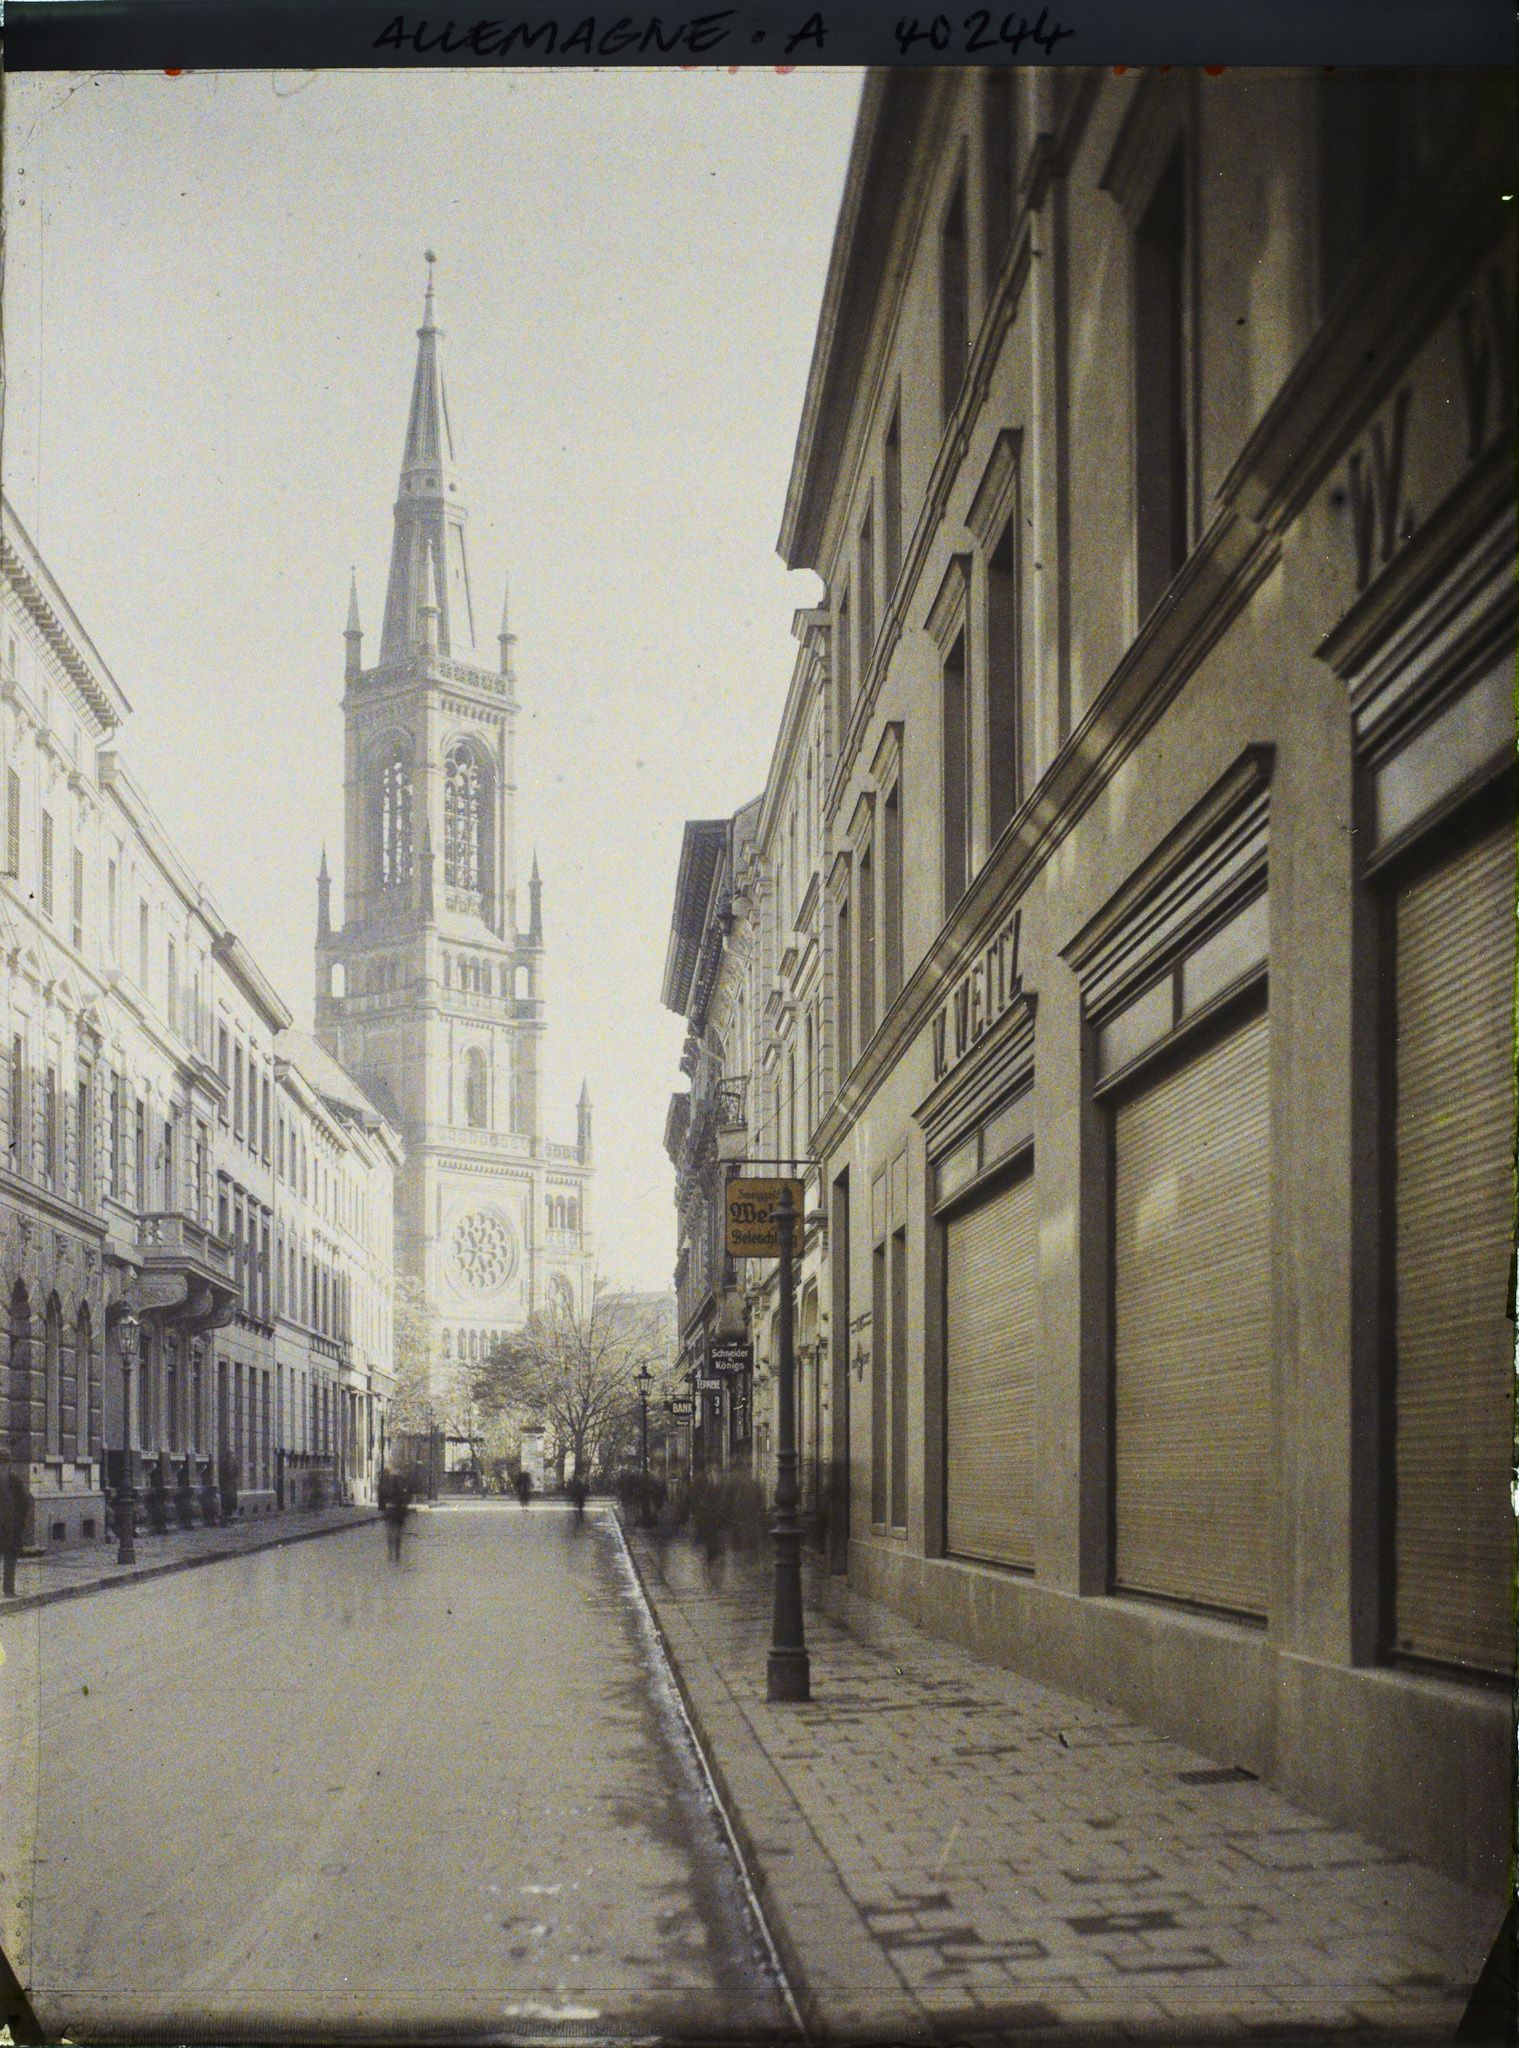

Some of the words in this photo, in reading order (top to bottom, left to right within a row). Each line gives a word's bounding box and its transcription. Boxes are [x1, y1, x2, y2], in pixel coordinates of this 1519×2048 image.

[784, 11, 829, 53] A
[895, 7, 1075, 55] 40244
[731, 1229, 798, 1249] Beleuchtg
[711, 1348, 748, 1357] Schneider
[715, 1361, 745, 1372] Königs
[672, 1402, 693, 1413] BANK
